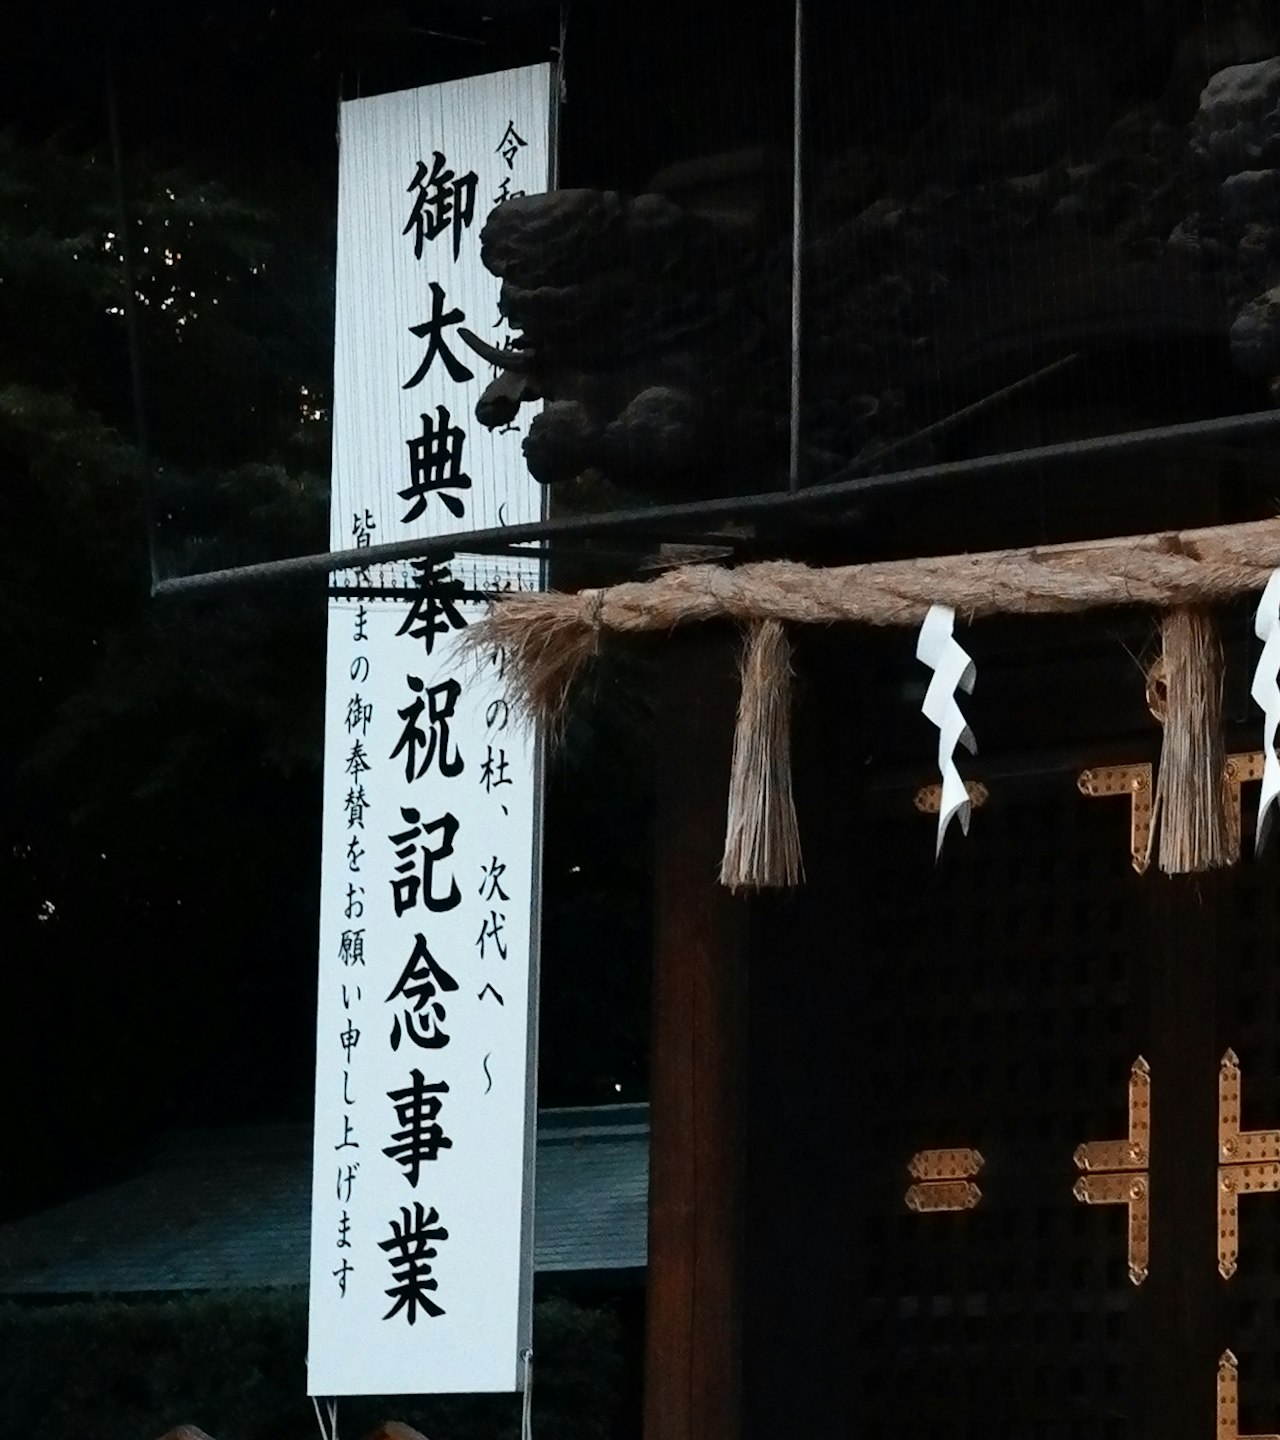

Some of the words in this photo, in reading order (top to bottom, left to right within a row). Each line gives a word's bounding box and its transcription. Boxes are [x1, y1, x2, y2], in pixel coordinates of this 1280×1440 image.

[376, 149, 480, 1326] 御大典奉祝記念事業
